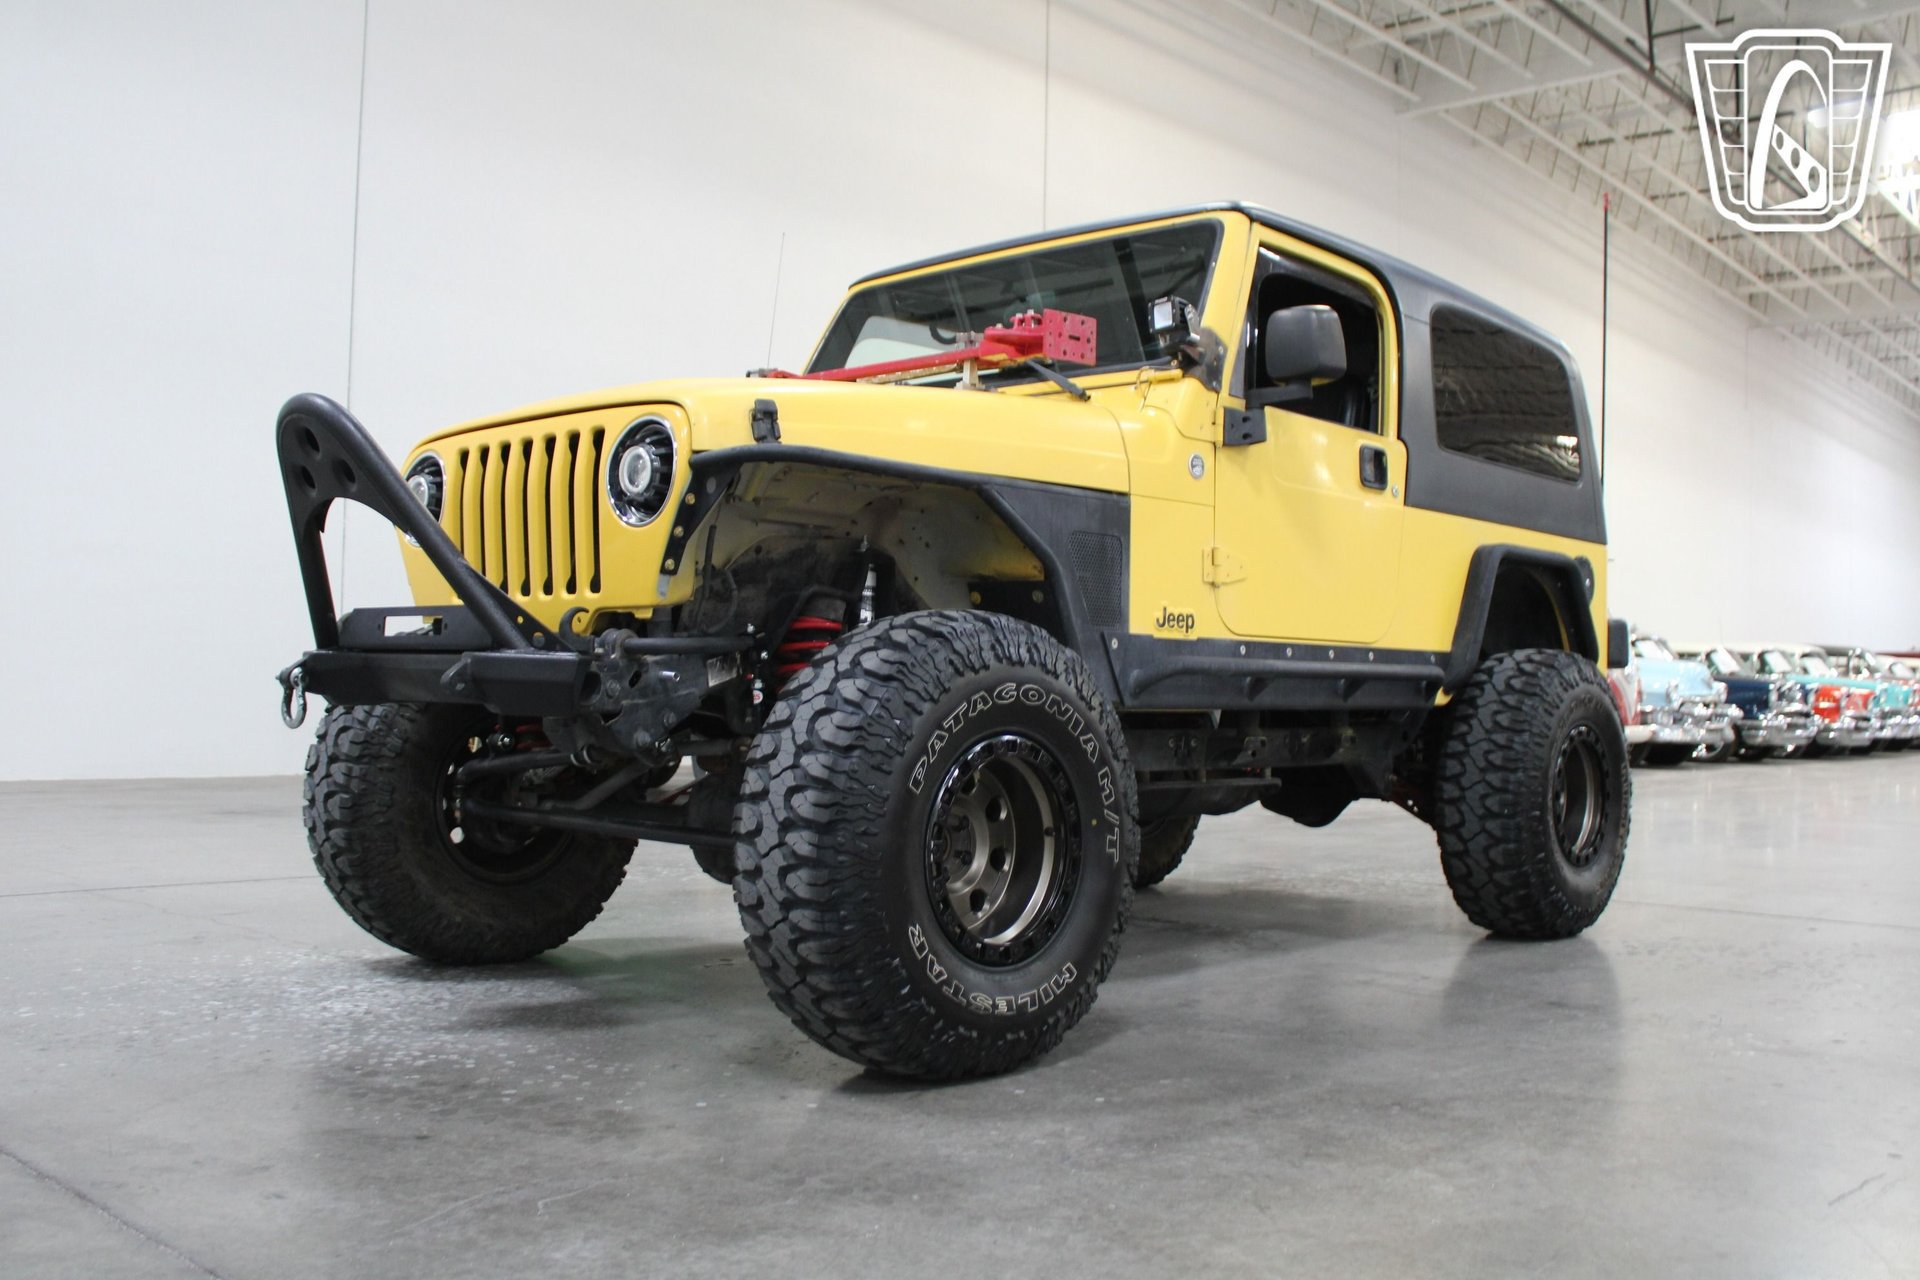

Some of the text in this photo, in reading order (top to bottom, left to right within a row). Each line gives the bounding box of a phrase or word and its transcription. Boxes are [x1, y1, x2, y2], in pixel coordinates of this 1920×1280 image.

[1156, 606, 1195, 634] Jeep
[908, 682, 1120, 863] PATAGONIA M/T
[908, 924, 1077, 1015] MILESTAR
